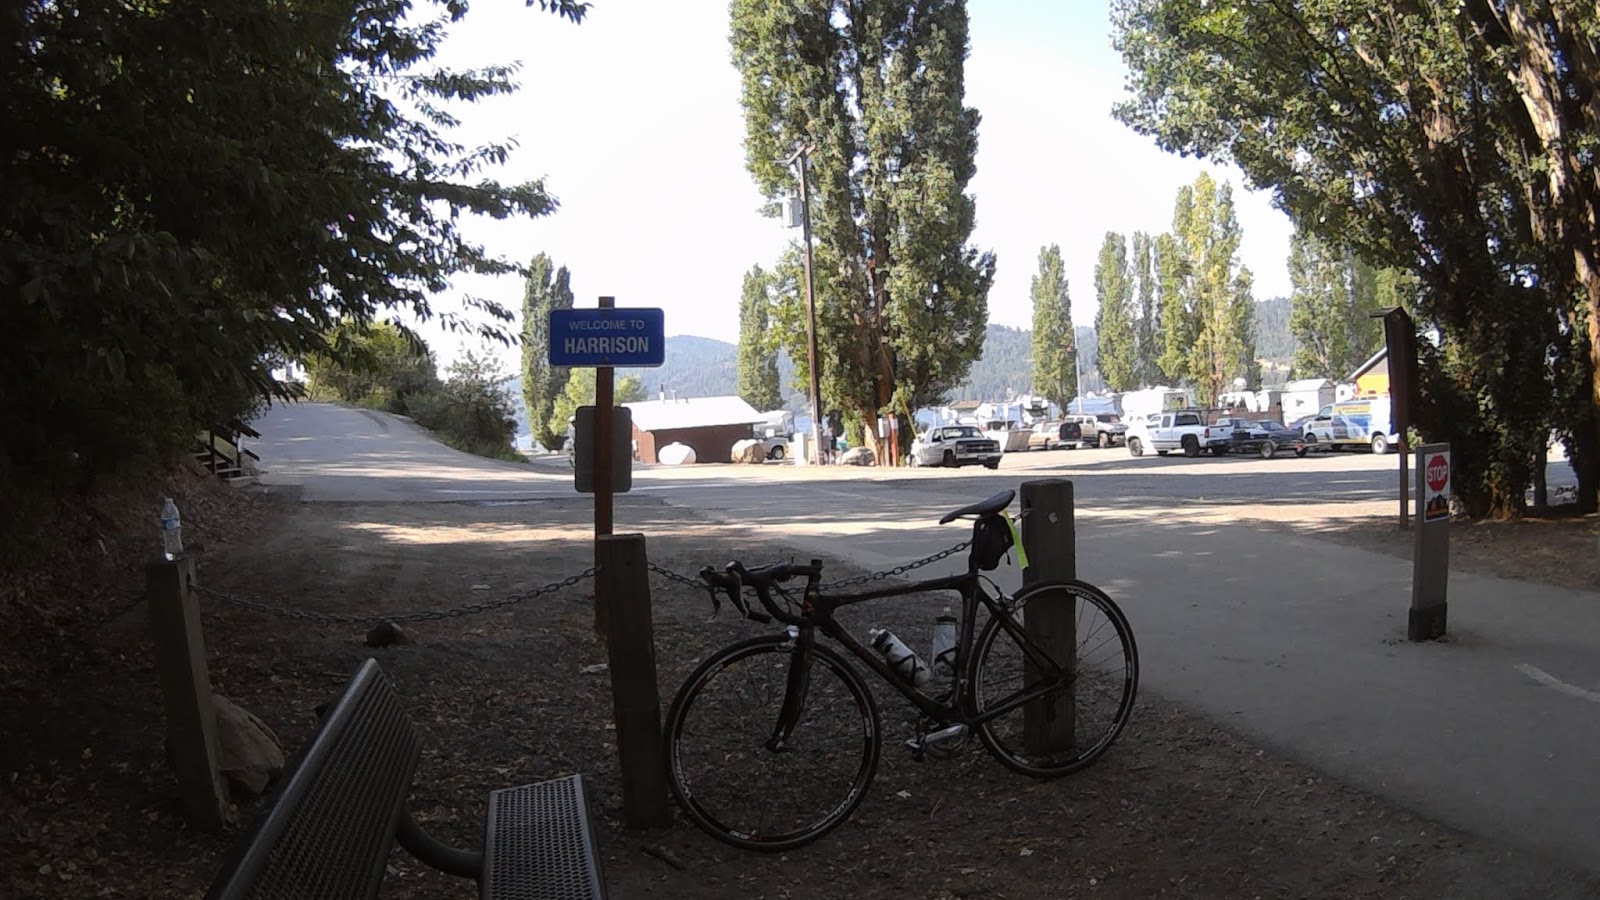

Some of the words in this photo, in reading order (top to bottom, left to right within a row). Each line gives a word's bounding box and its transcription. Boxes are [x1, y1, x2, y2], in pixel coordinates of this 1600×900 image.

[569, 320, 626, 330] WELCOME
[630, 320, 645, 330] TO
[564, 336, 649, 353] HARRISON
[1428, 465, 1447, 482] STOP
